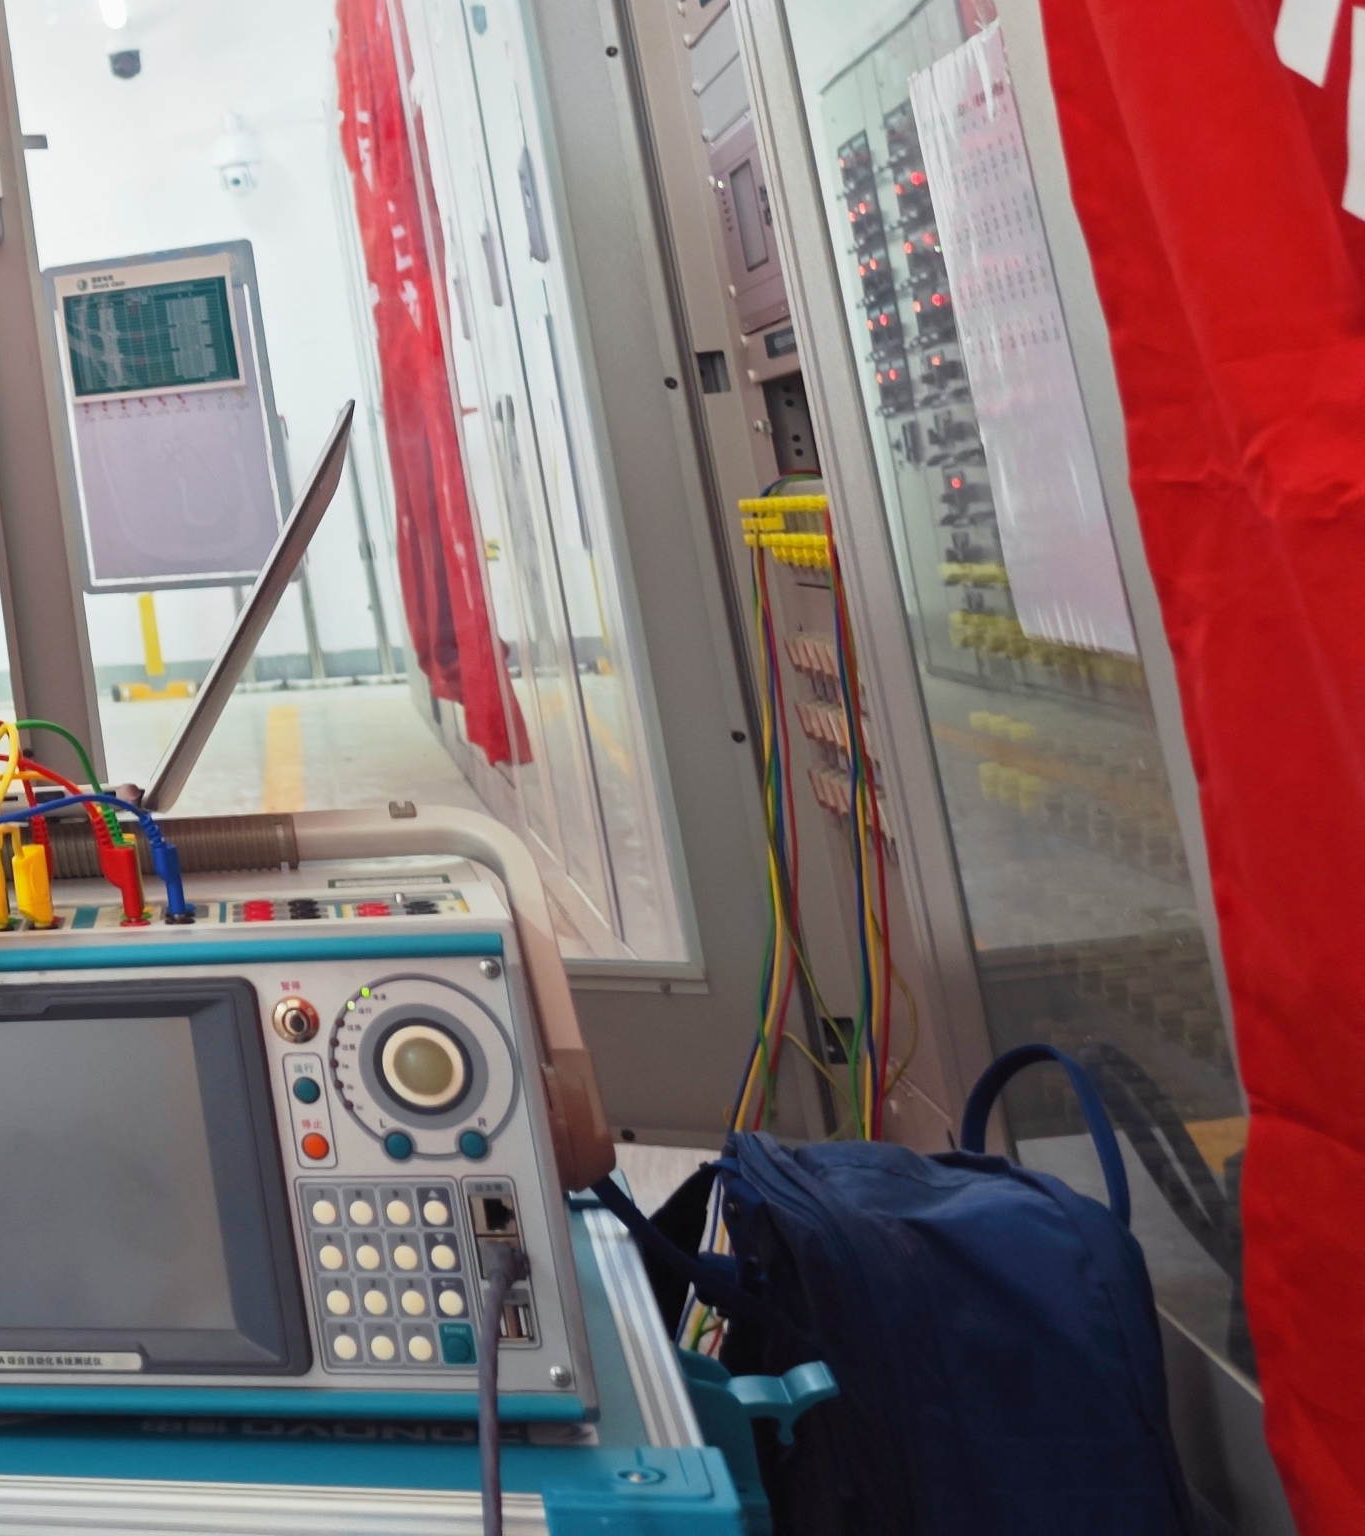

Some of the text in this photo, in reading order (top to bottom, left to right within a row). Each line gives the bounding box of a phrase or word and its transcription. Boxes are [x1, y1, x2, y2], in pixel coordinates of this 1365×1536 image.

[280, 980, 302, 991] 暂停
[293, 1063, 314, 1074] 运行
[301, 1119, 323, 1130] 停止
[379, 1119, 386, 1128] L
[477, 1117, 487, 1128] R
